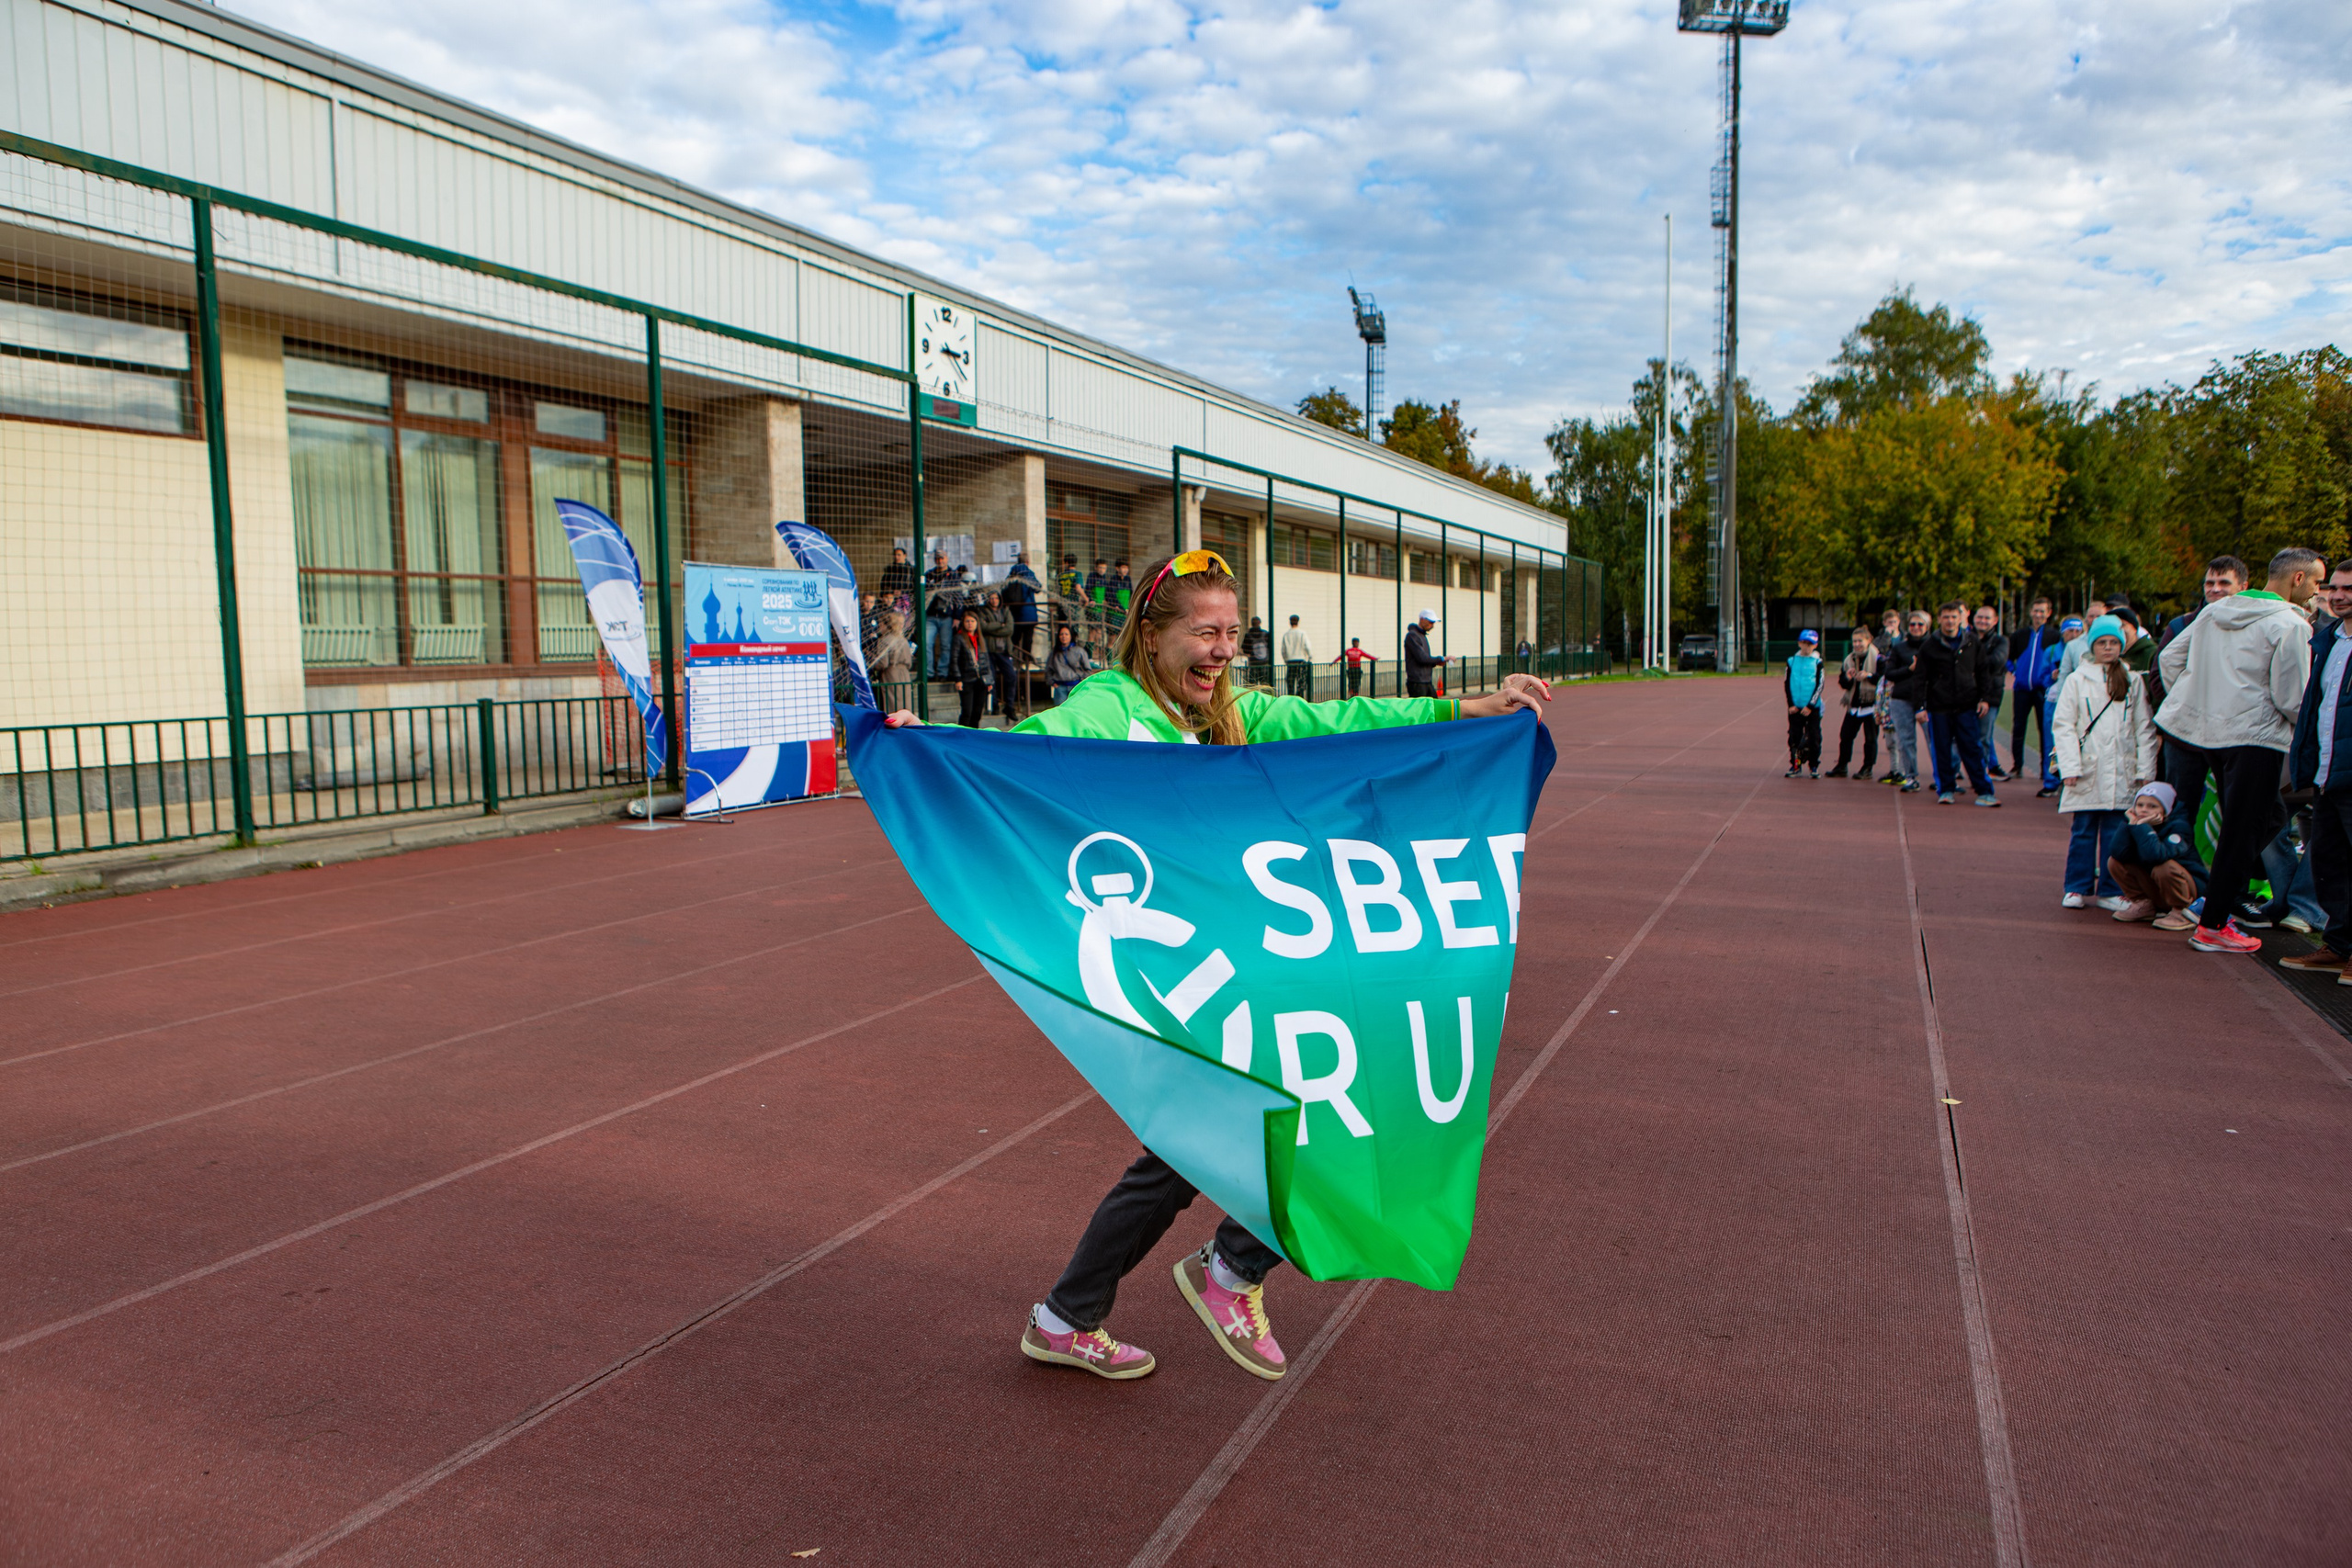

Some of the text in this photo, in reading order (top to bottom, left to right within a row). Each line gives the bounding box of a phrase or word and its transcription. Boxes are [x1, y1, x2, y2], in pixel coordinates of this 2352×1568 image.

[941, 306, 951, 322] 12
[922, 338, 929, 353] 9
[963, 350, 969, 365] 3
[944, 381, 950, 396] 6
[762, 593, 792, 609] 2025
[778, 615, 791, 625] ТЭК
